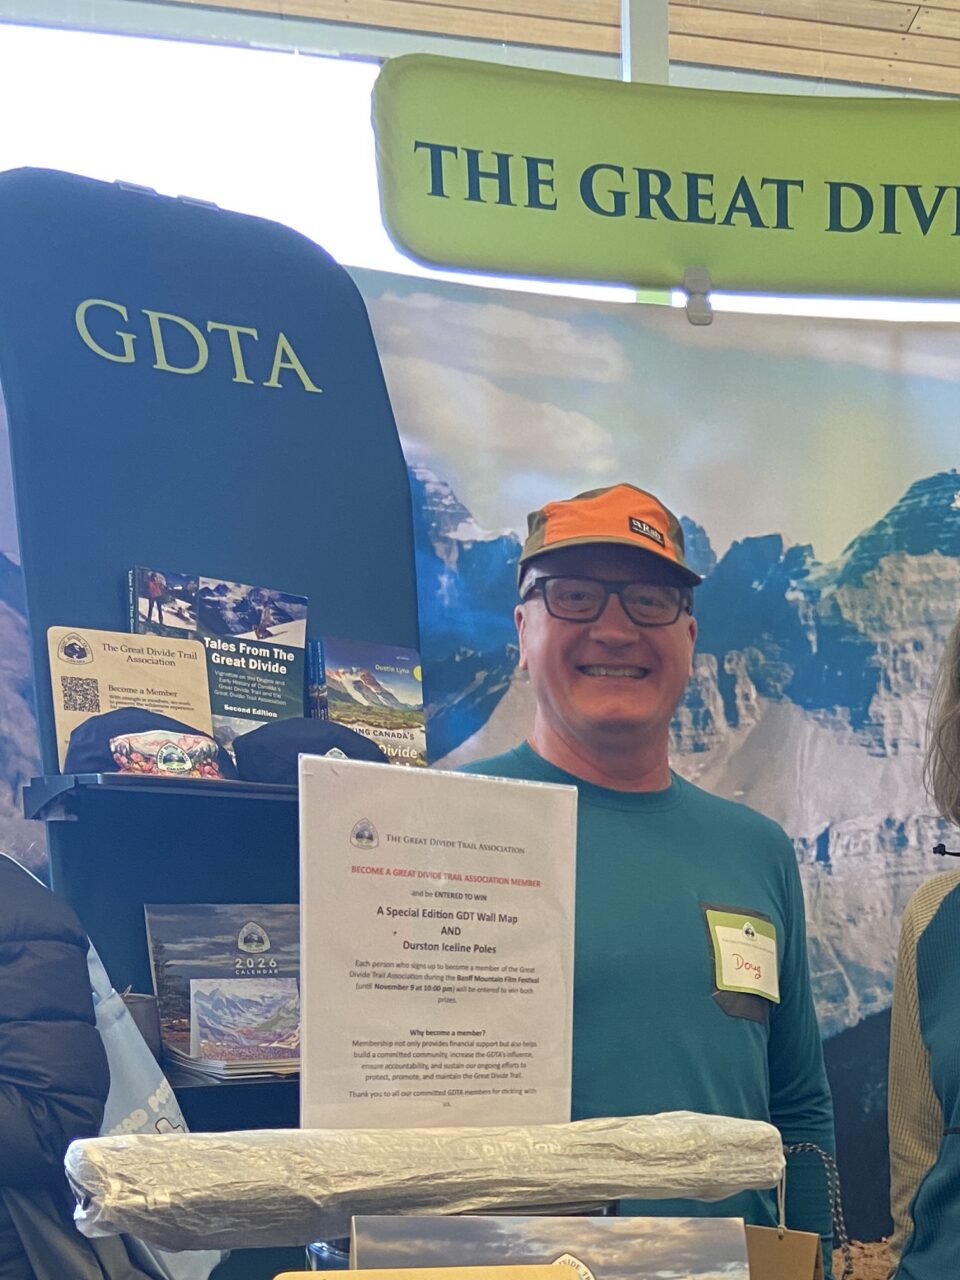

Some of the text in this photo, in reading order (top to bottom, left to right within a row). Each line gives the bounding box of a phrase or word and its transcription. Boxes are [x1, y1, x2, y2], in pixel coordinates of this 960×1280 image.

[413, 140, 557, 211] THE
[579, 162, 804, 232] GREAT
[75, 298, 323, 393] GDTA
[102, 643, 197, 660] The Great Divide Trail
[204, 637, 295, 662] Tales From The
[126, 655, 176, 666] Association
[211, 653, 287, 674] Great Divide
[108, 685, 138, 694] Become
[145, 688, 178, 697] Member
[224, 704, 278, 718] Second Edition
[373, 728, 415, 740] CANADA'S
[386, 833, 525, 854] THE GREAT DIVIDE TRAIL ASSOCIATION
[351, 865, 541, 887] BECOME A GREAT DIVIDE TRAIL ASSOCIATION MEMBER
[434, 891, 463, 900] ENTERED
[376, 906, 518, 925] A Special Edition GDT Wall Map
[441, 927, 461, 936] AND
[403, 940, 496, 954] Durston Iceline Poles
[235, 958, 277, 968] 2026
[732, 954, 762, 979] Doug
